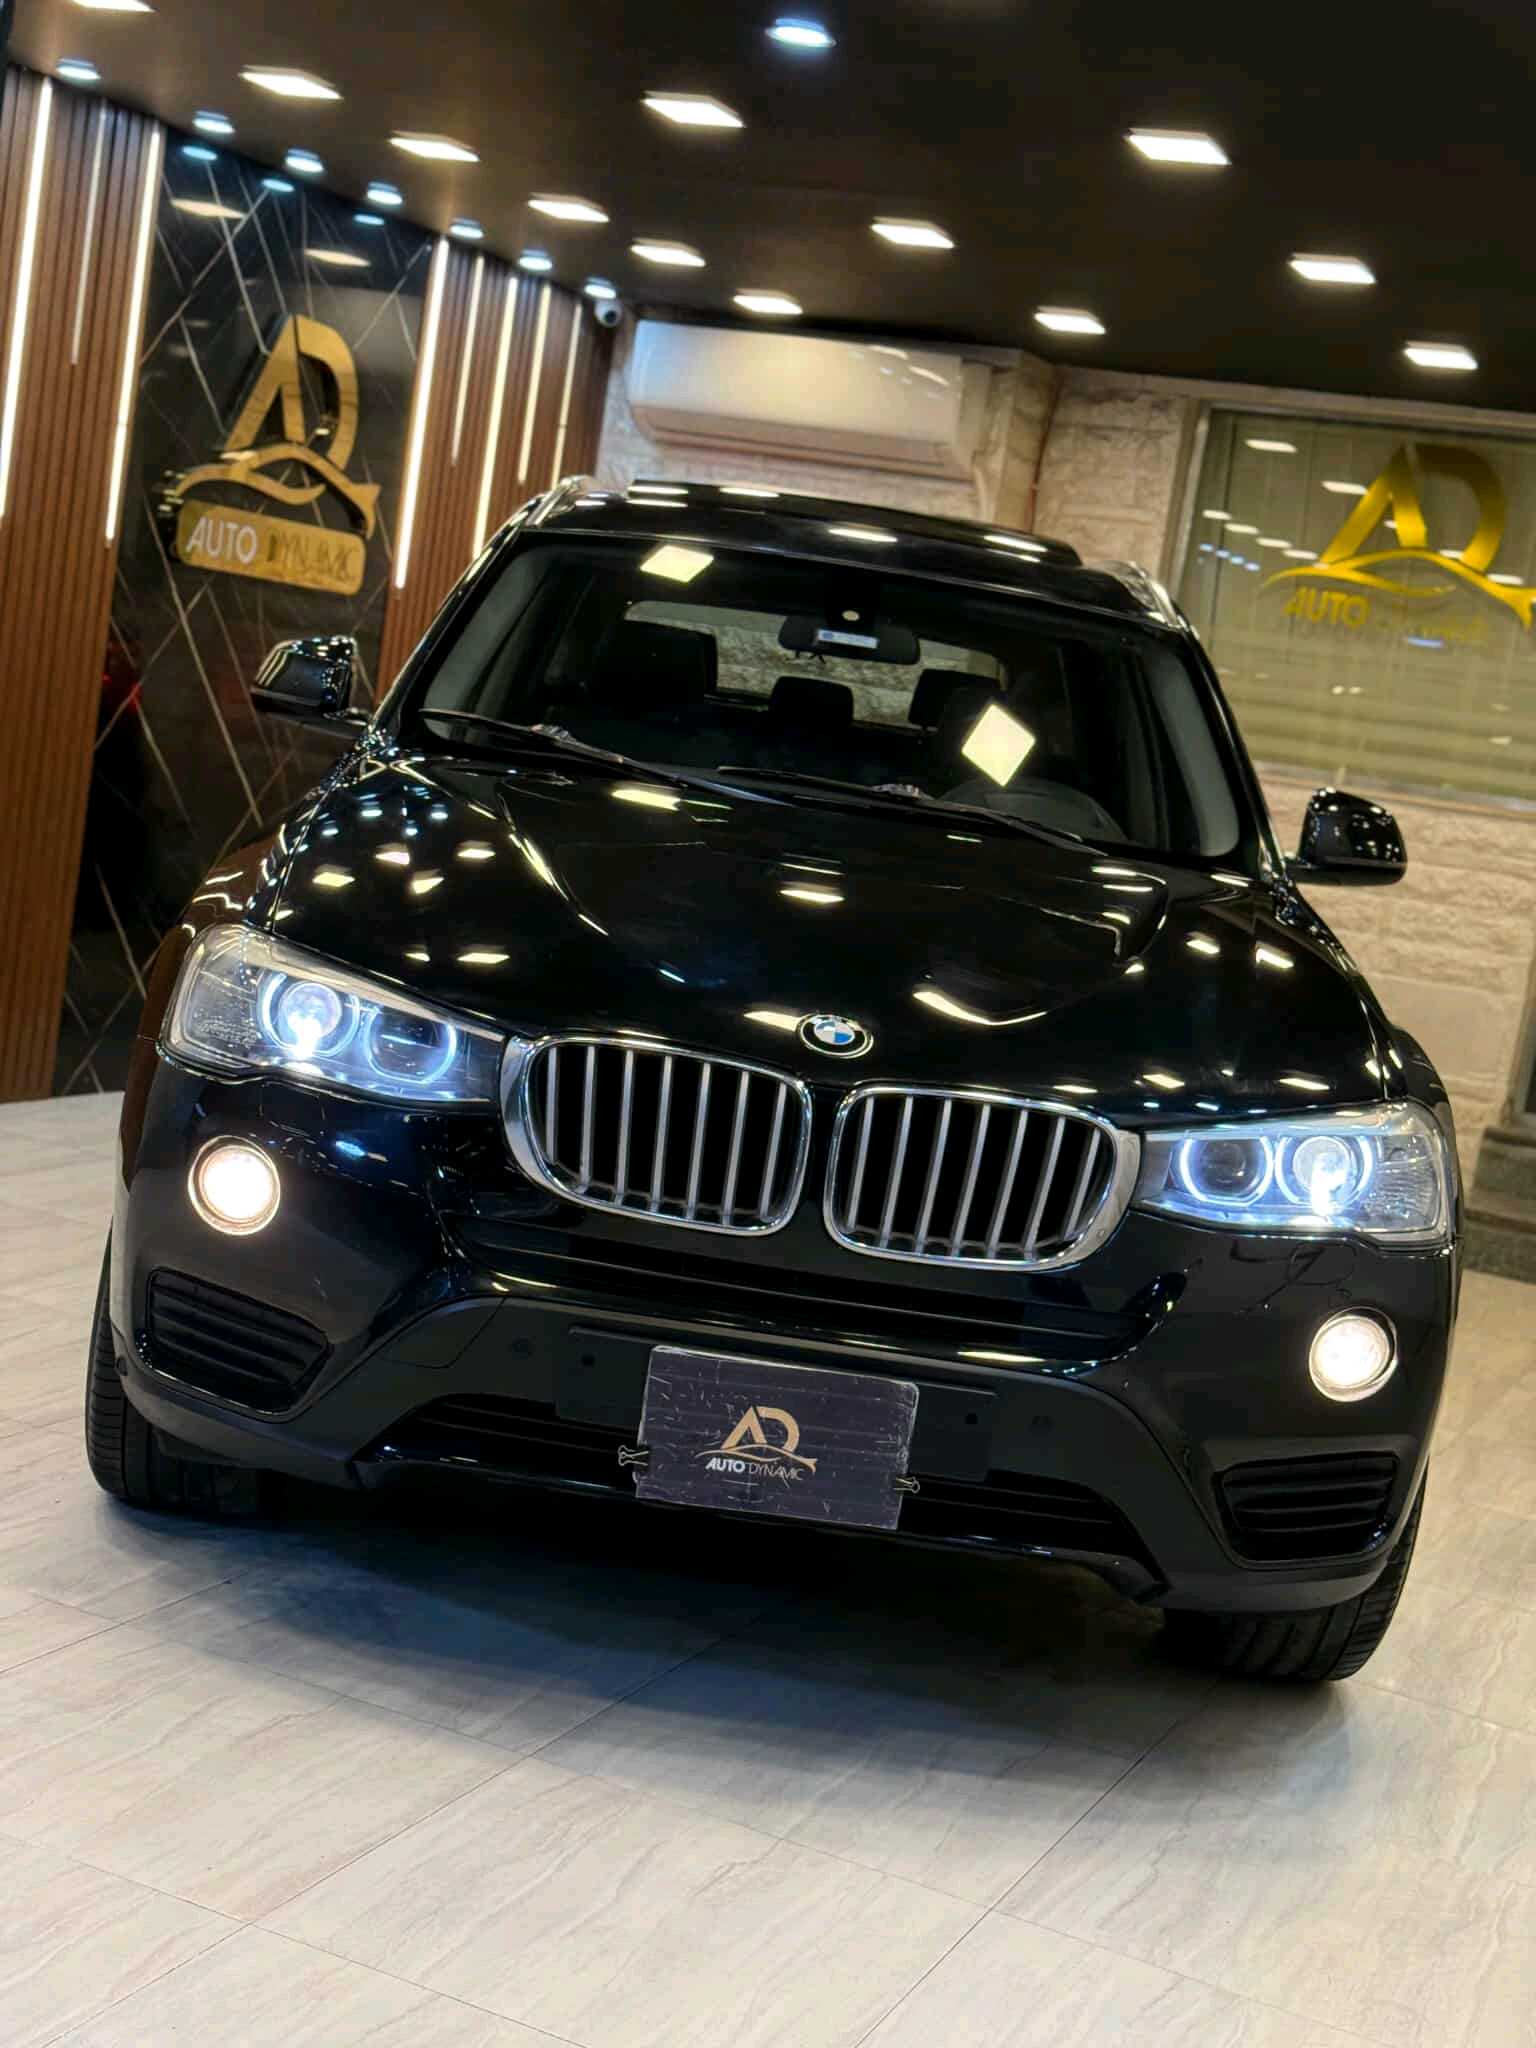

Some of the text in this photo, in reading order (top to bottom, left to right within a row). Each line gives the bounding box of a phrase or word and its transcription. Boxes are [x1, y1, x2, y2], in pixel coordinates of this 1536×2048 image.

[186, 516, 257, 564] AUTO
[1285, 586, 1370, 627] AUTO
[705, 1457, 804, 1480] AUTO DYNAMIC
